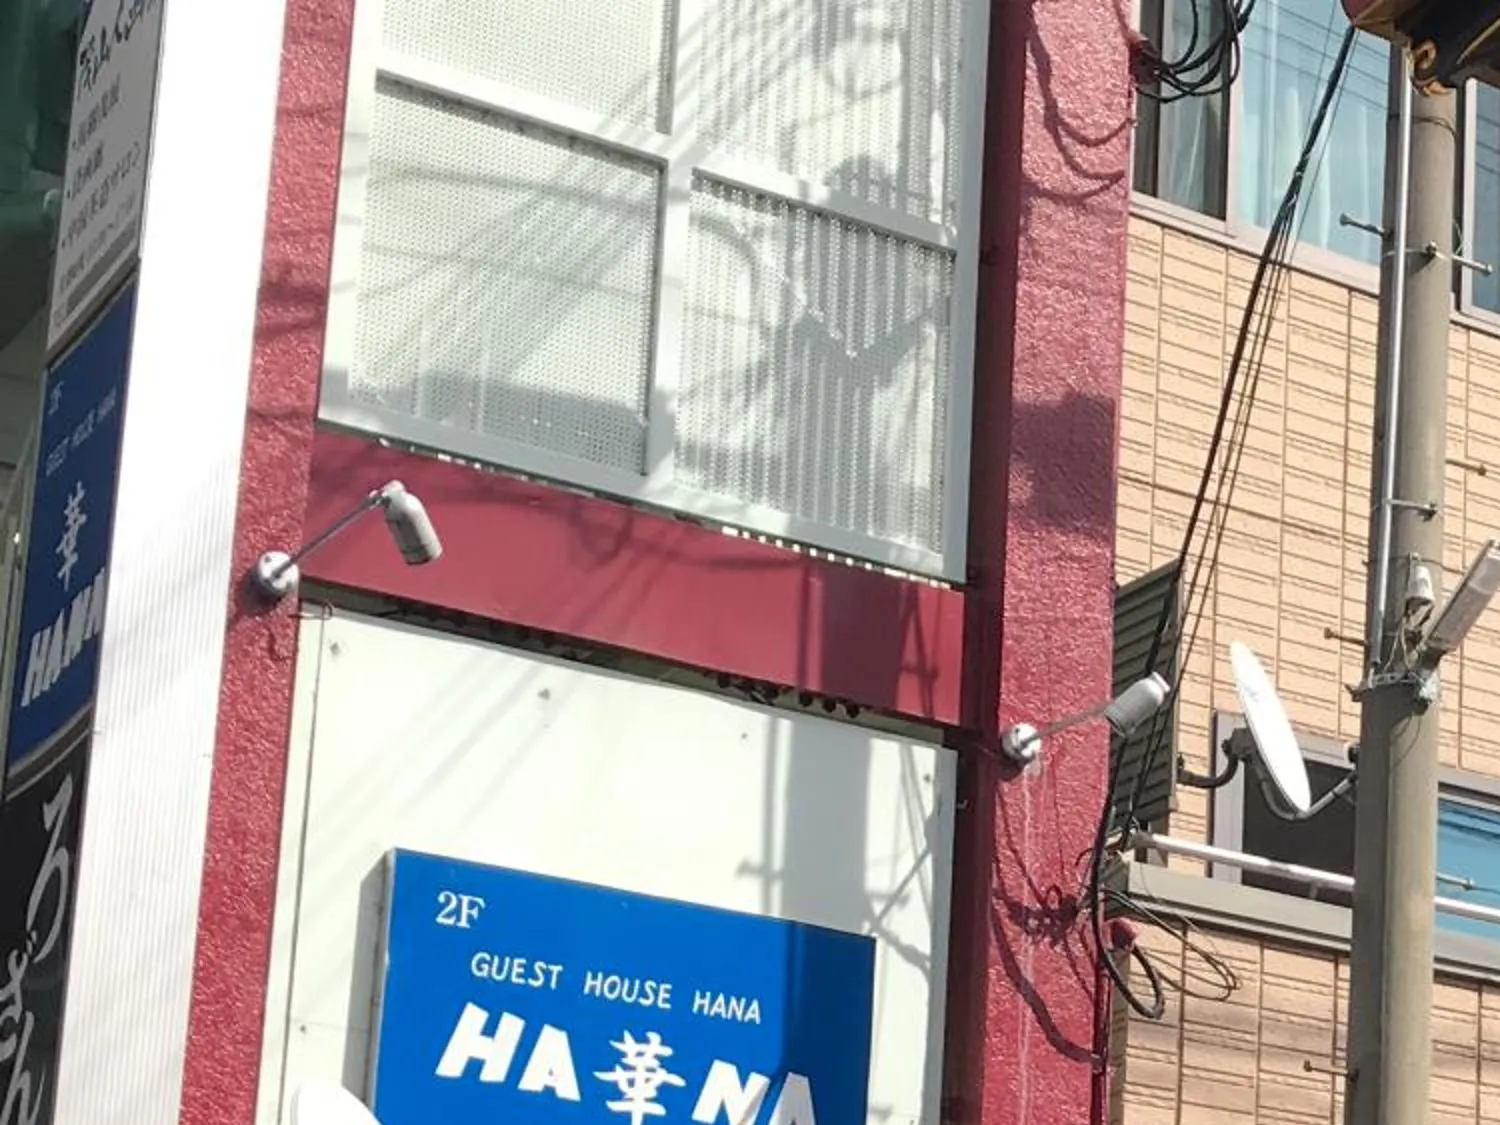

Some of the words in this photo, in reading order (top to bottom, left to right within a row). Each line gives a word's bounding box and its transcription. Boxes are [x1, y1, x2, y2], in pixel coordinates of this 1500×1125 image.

[435, 891, 485, 928] 2F
[471, 952, 563, 990] GUEST
[584, 971, 672, 1009] HOUSE
[693, 990, 762, 1025] HANA
